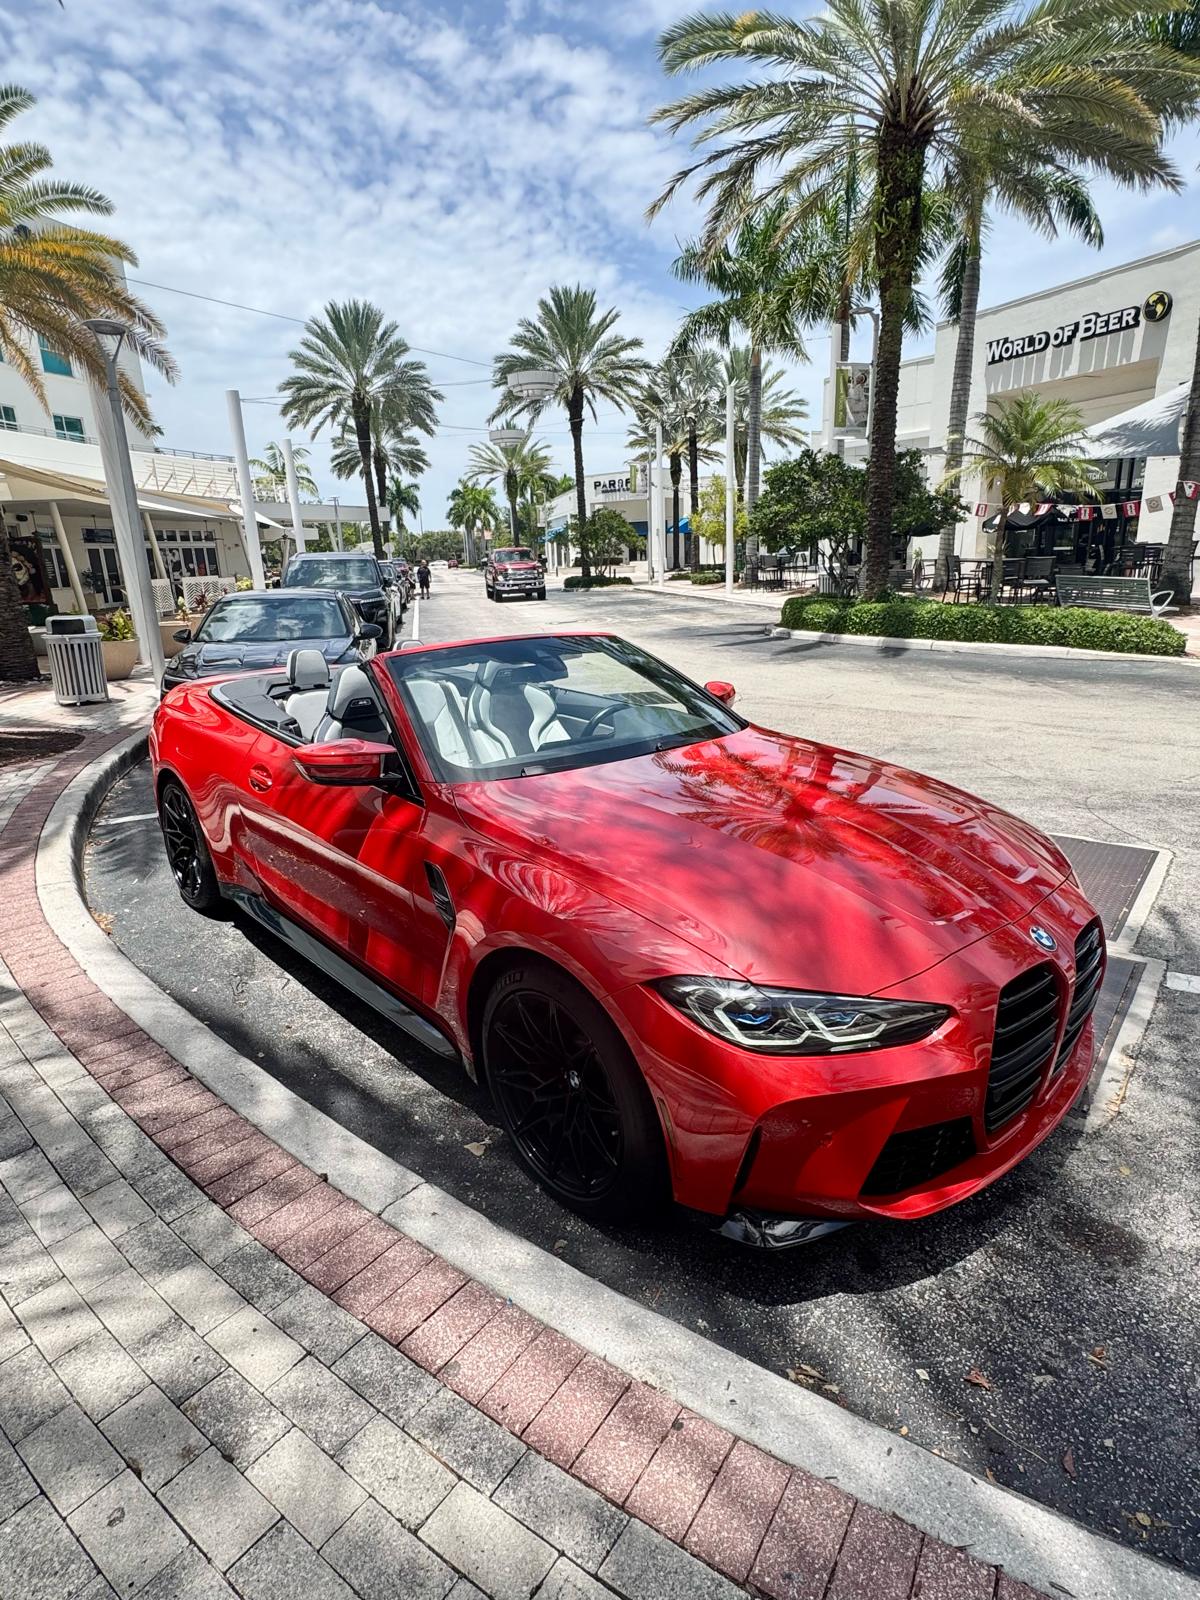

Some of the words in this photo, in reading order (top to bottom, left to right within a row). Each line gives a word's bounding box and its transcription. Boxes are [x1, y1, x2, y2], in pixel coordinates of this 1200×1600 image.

[986, 332, 1048, 364] WORLD
[1051, 323, 1078, 347] OF
[1079, 306, 1139, 340] BEER
